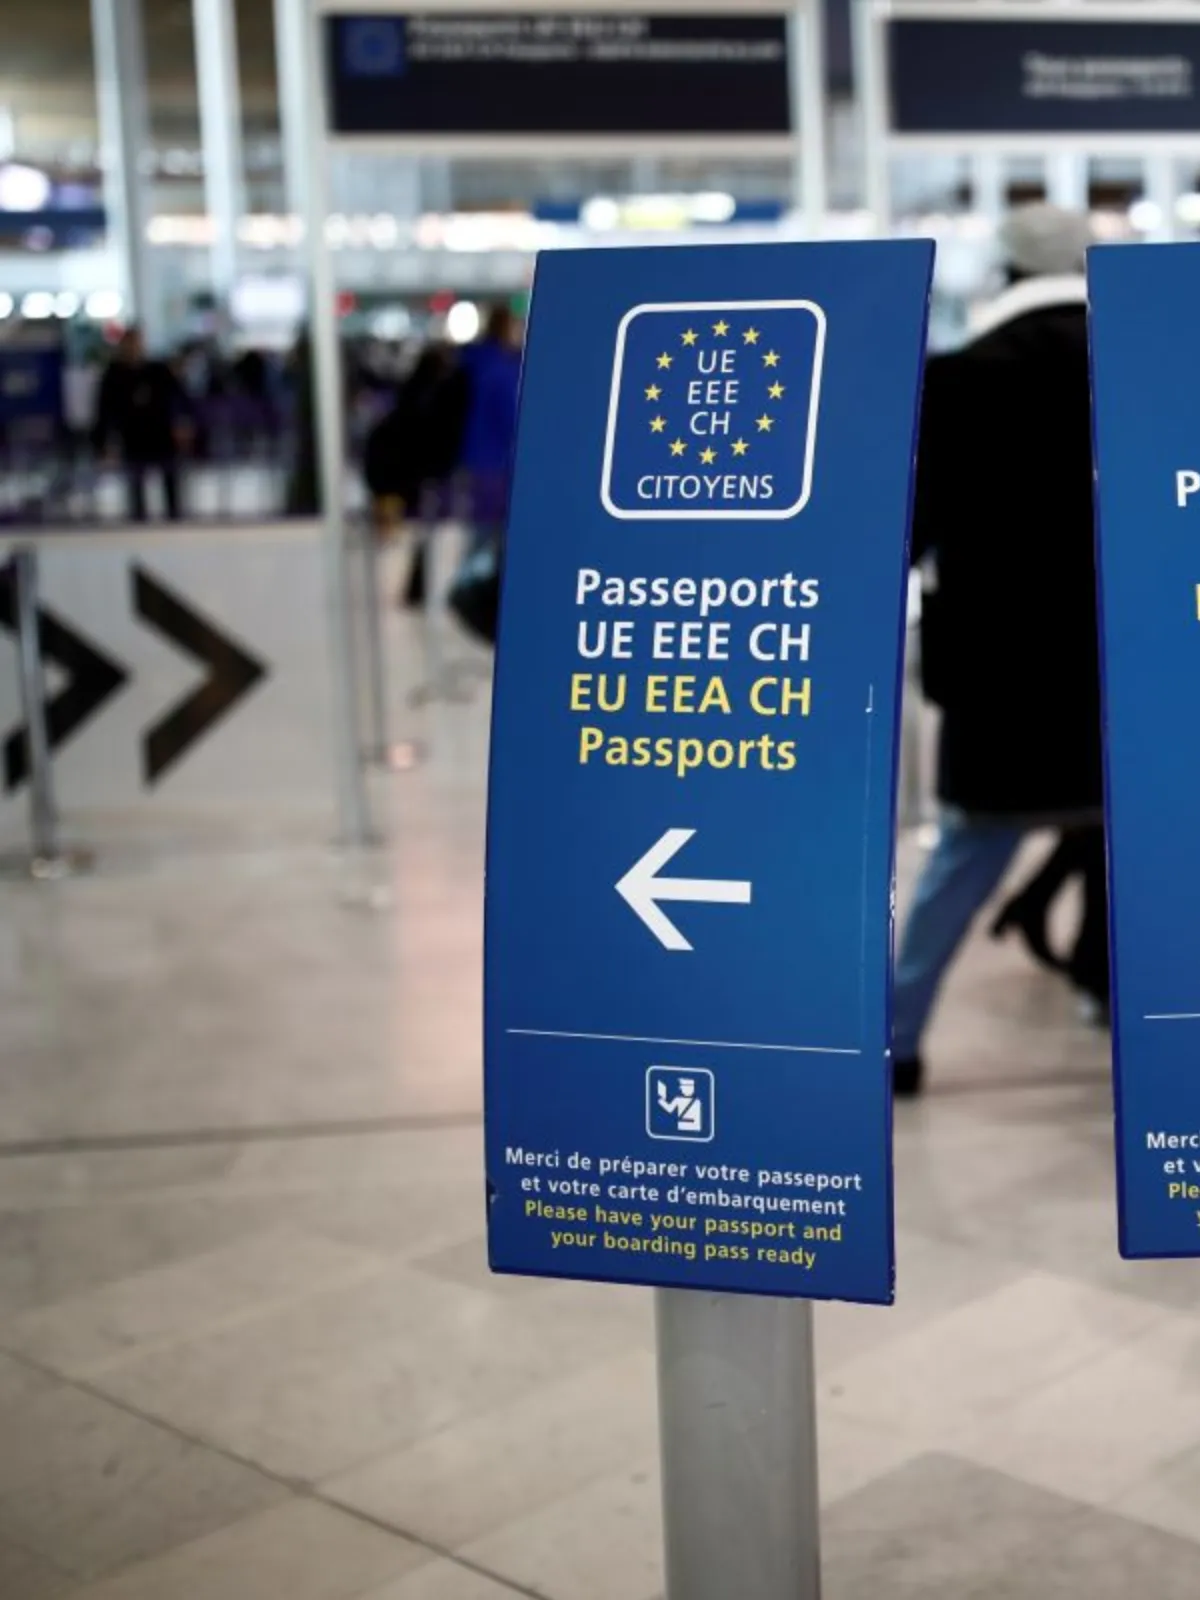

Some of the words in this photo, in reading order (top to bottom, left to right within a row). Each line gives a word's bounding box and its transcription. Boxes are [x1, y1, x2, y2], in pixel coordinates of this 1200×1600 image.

[698, 349, 736, 374] UE
[687, 380, 739, 404] EEE
[690, 411, 730, 435] CH
[637, 474, 773, 499] CITOYENS
[576, 569, 819, 617] Passeports
[578, 621, 634, 658] UE
[653, 621, 731, 660] EEE
[749, 623, 810, 661] CH
[571, 673, 626, 712] EU
[646, 675, 731, 714] EEA
[750, 676, 811, 716] CH
[579, 727, 796, 777] Passports
[506, 1147, 559, 1168] Merci
[567, 1151, 591, 1171] de
[599, 1156, 688, 1178] préparer
[695, 1165, 750, 1182] votre
[758, 1170, 861, 1192] passeport
[1163, 1158, 1185, 1174] et
[521, 1176, 541, 1192] et
[548, 1179, 600, 1197] votre
[608, 1185, 659, 1201] carte
[667, 1185, 845, 1215] d'embarquement
[525, 1200, 588, 1221] Please
[595, 1205, 643, 1226] have
[650, 1214, 697, 1231] your
[705, 1218, 795, 1239] passport
[803, 1224, 841, 1241] and
[551, 1231, 597, 1248] your
[603, 1231, 696, 1260] boarding
[704, 1244, 749, 1261] pass
[757, 1247, 816, 1270] ready
